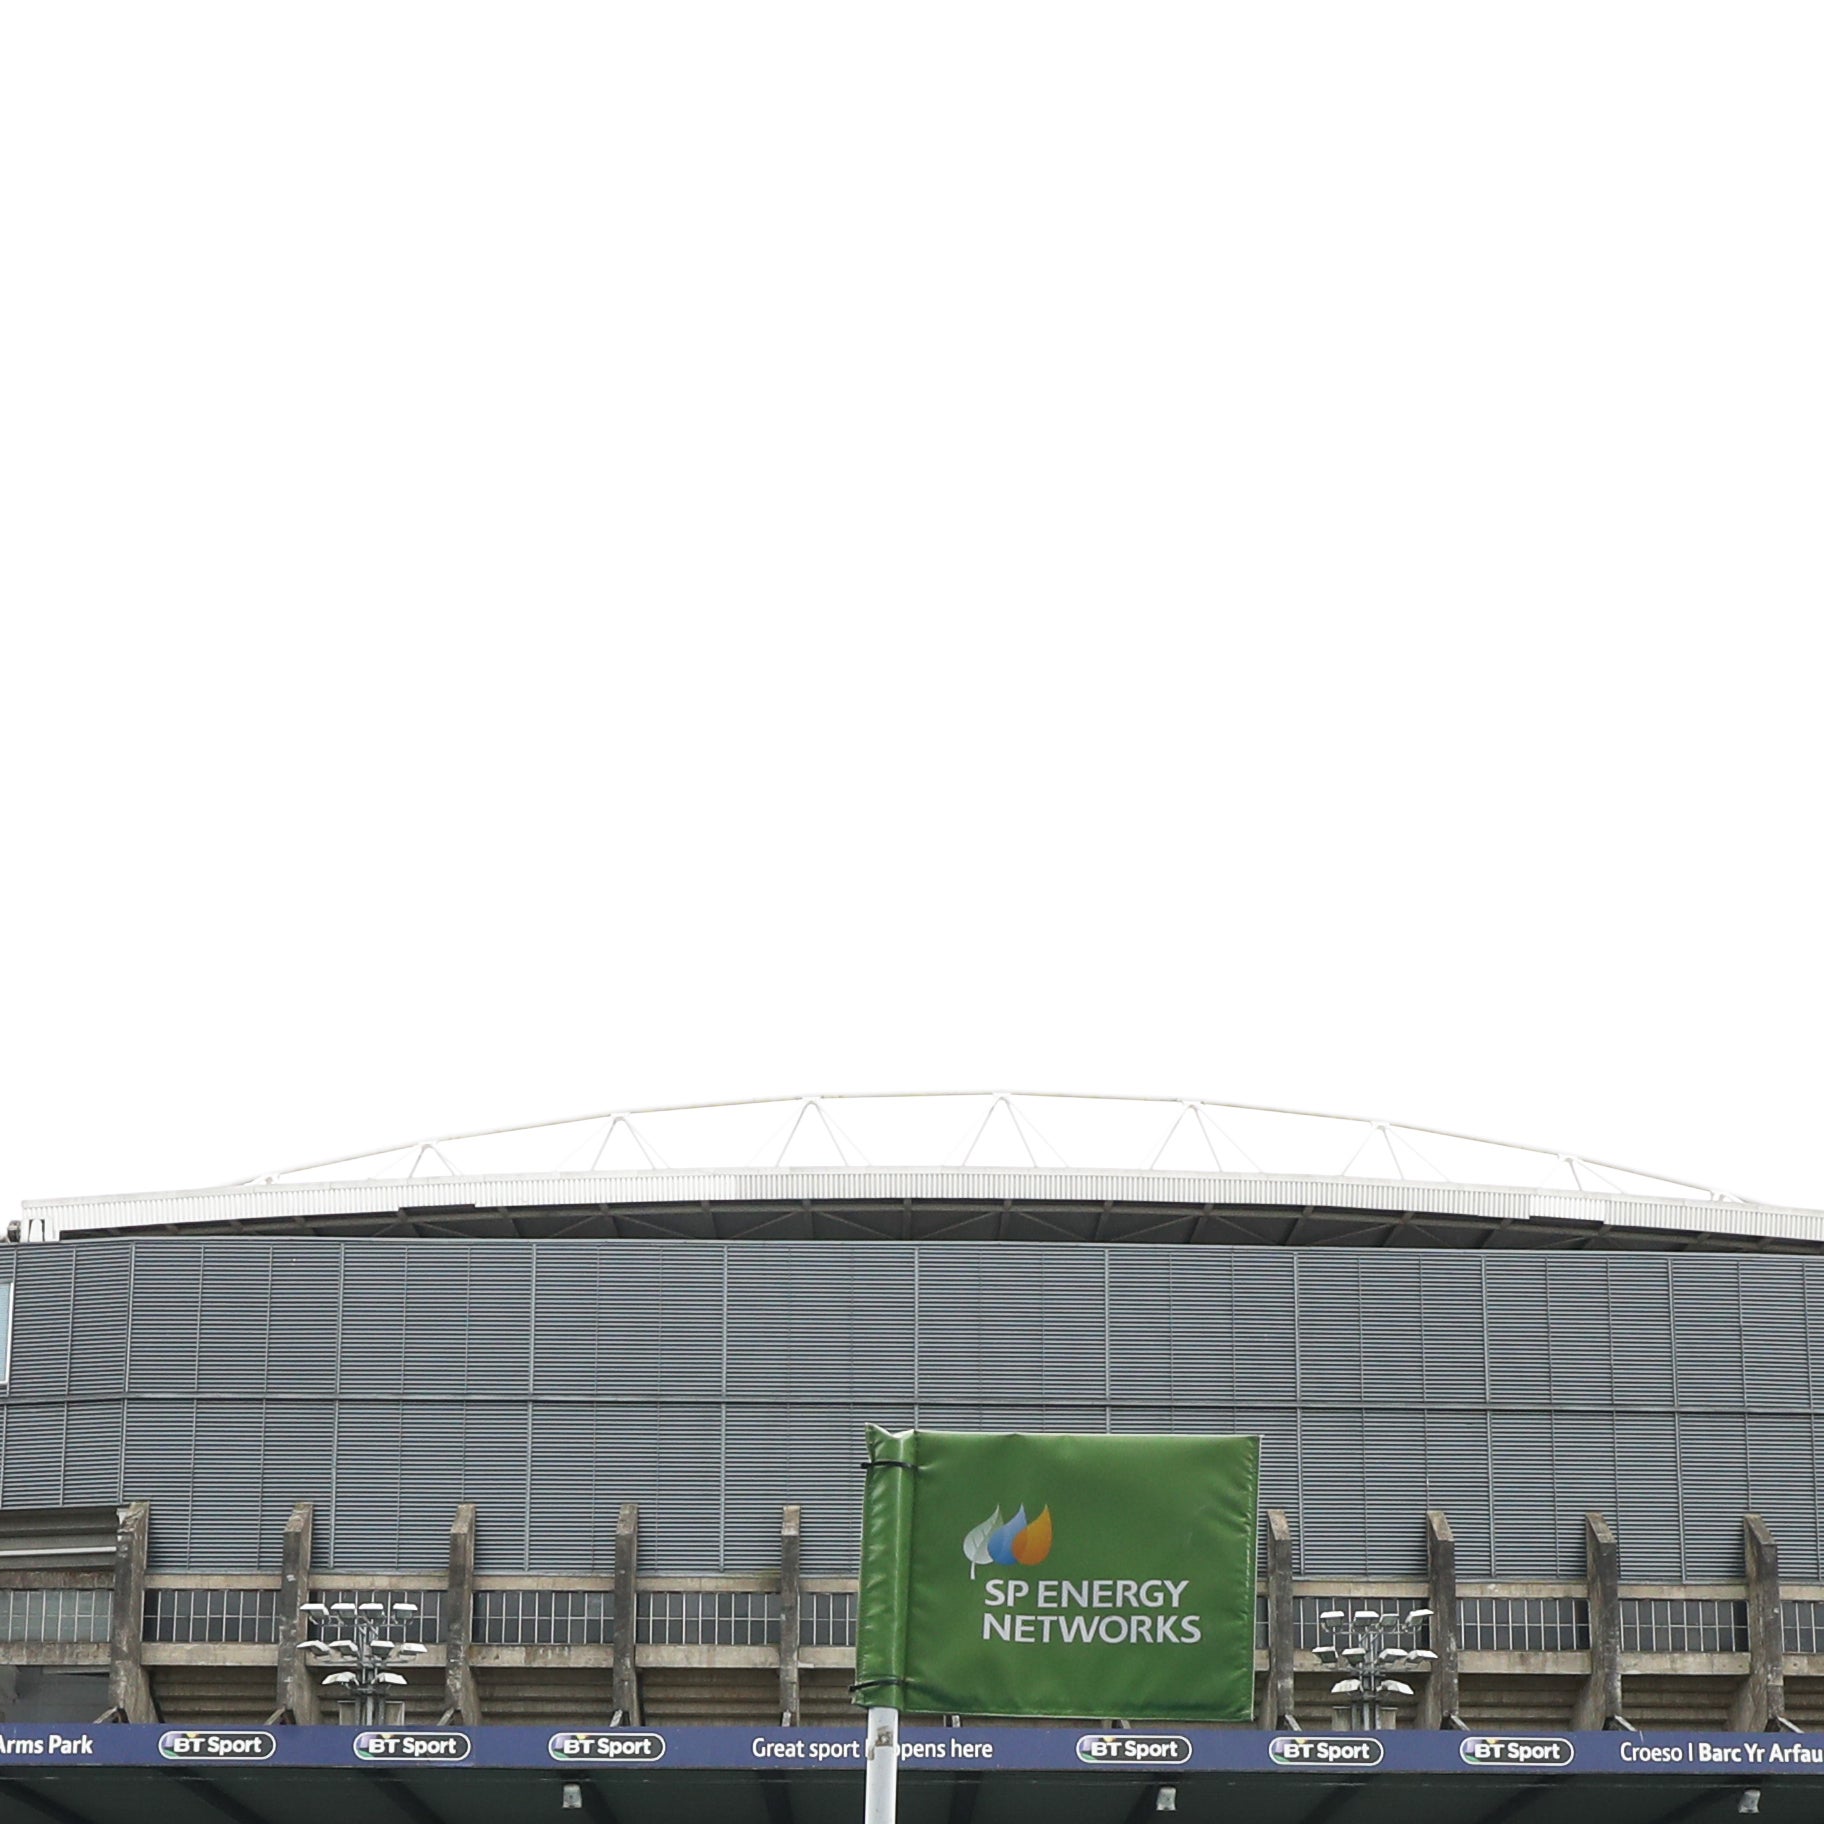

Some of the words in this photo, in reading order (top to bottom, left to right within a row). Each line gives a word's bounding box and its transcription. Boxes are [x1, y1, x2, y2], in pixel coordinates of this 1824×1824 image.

[984, 1579, 1029, 1607] SP
[1037, 1579, 1190, 1609] ENERGY
[982, 1613, 1202, 1644] NETWORKS
[47, 1734, 94, 1754] Park
[173, 1736, 205, 1753] BT
[207, 1736, 263, 1755] Sport
[369, 1738, 402, 1754] BT
[403, 1737, 458, 1757] Sport
[563, 1738, 596, 1754] BT
[597, 1738, 652, 1757] Sport
[752, 1737, 805, 1758] Great
[809, 1738, 861, 1761] sport
[865, 1738, 947, 1761] pens
[951, 1738, 993, 1758] here
[1091, 1741, 1122, 1758] BT
[1124, 1740, 1178, 1760] Sport
[1284, 1743, 1314, 1759] BT
[1316, 1743, 1370, 1761] Sport
[1475, 1743, 1505, 1759] BT
[1507, 1743, 1561, 1761] Sport
[1620, 1742, 1682, 1762] Croeso
[1699, 1743, 1741, 1763] Barc
[1744, 1744, 1766, 1763] Yr
[1769, 1743, 1823, 1763] Arfau
